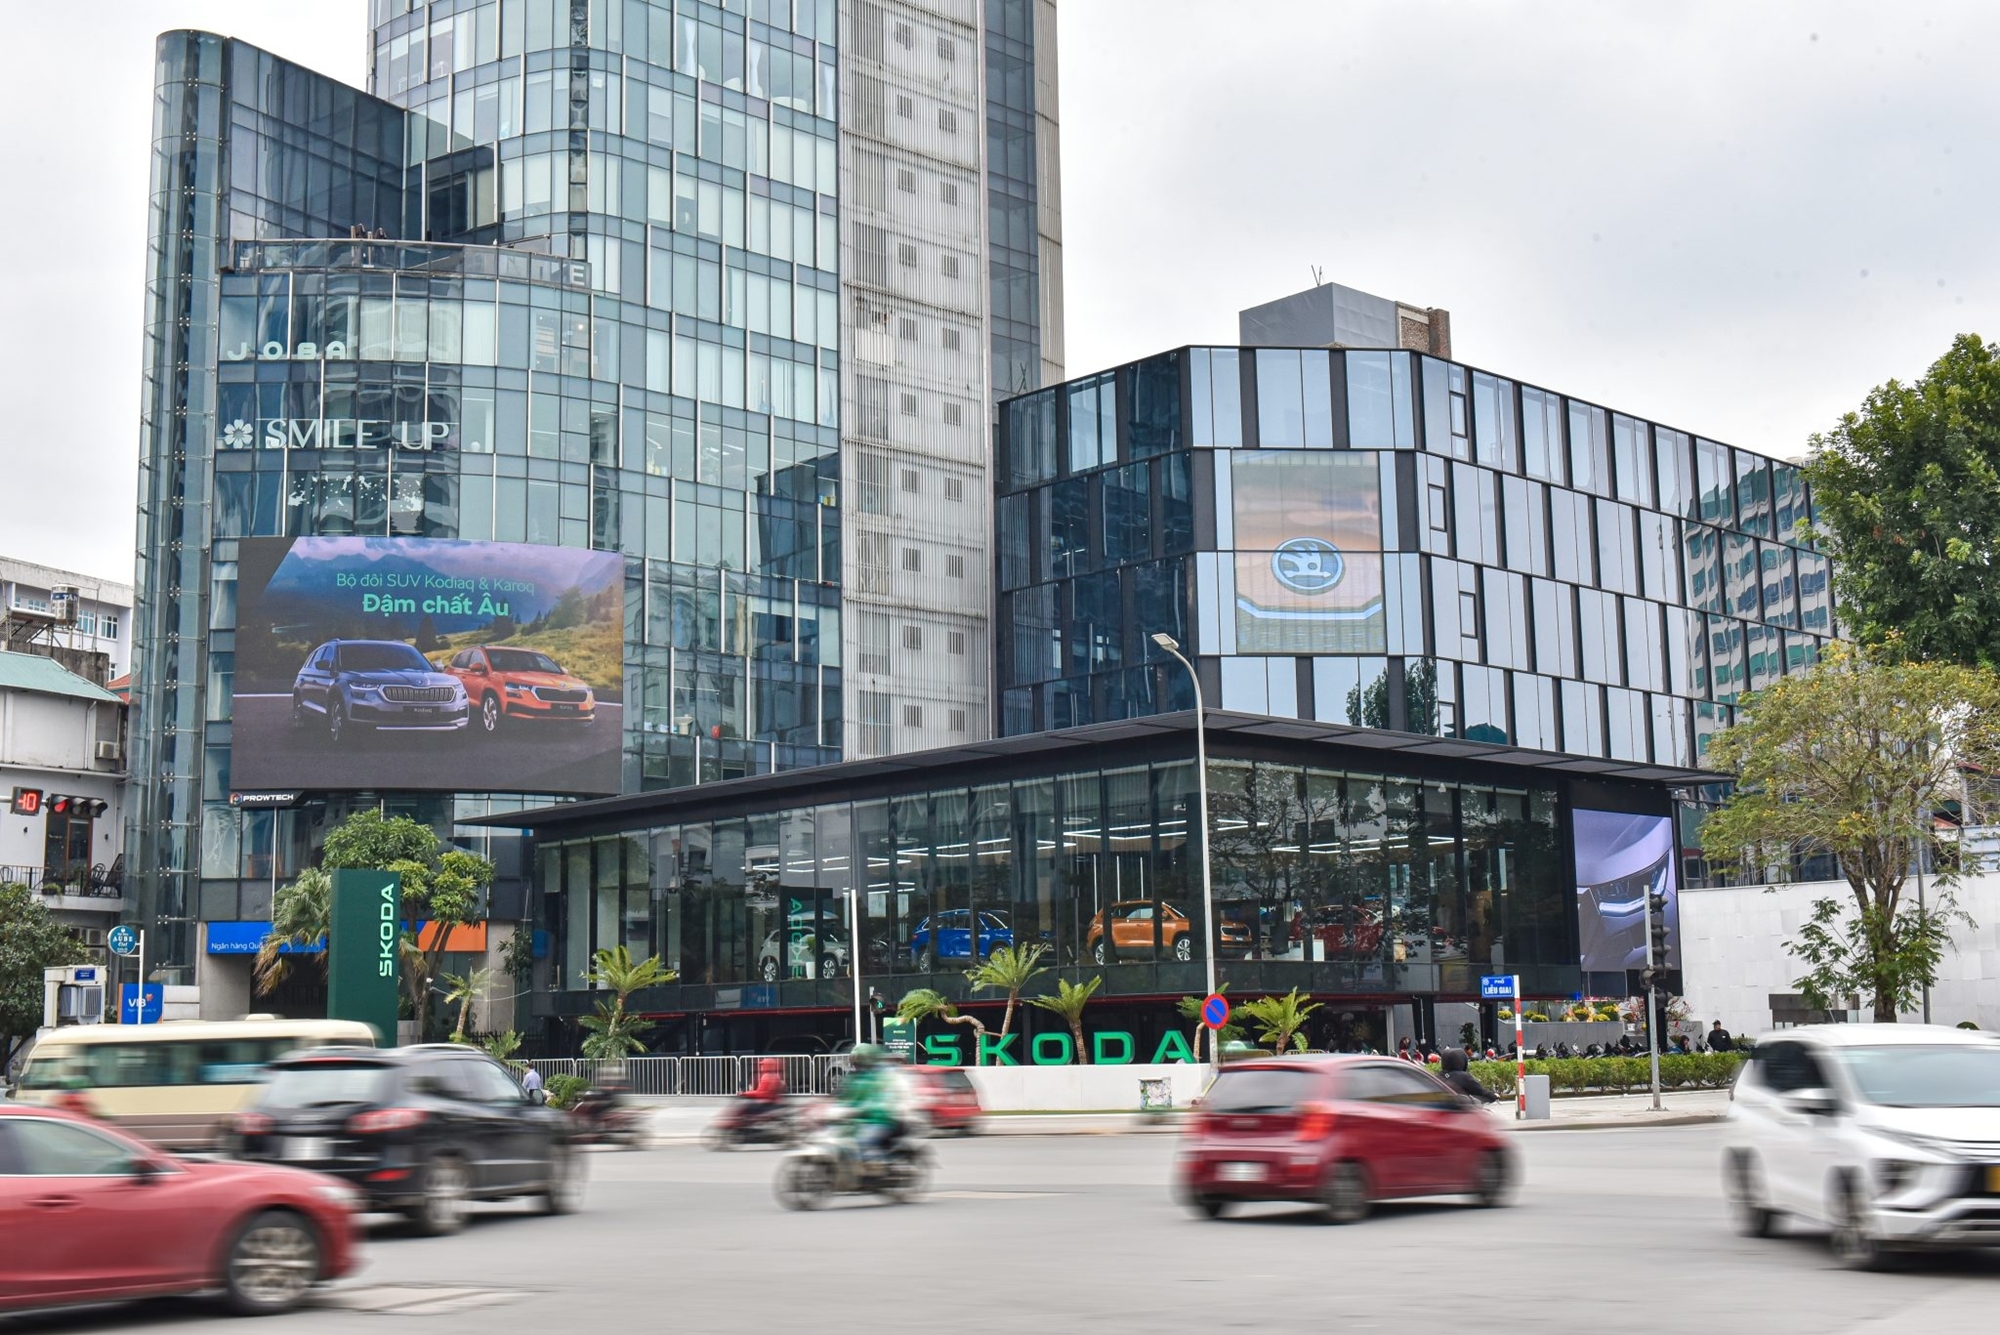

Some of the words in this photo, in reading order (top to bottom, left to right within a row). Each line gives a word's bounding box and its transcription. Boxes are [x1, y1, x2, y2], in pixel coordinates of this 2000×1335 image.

[226, 340, 347, 360] JOBA
[266, 418, 378, 449] SMILE
[401, 420, 450, 450] UP
[336, 573, 356, 589] Bộ
[360, 574, 383, 587] đôi
[387, 574, 421, 588] SUV
[425, 575, 475, 593] Kodiaq
[479, 576, 489, 590] &
[493, 578, 535, 596] Karoq
[362, 593, 416, 617] Đậm
[422, 592, 472, 615] chất
[477, 592, 509, 616] Âu
[243, 794, 294, 802] PROWTECH
[230, 941, 248, 951] hàng
[1498, 986, 1512, 994] GIAI
[925, 1030, 1199, 1066] SKODA
